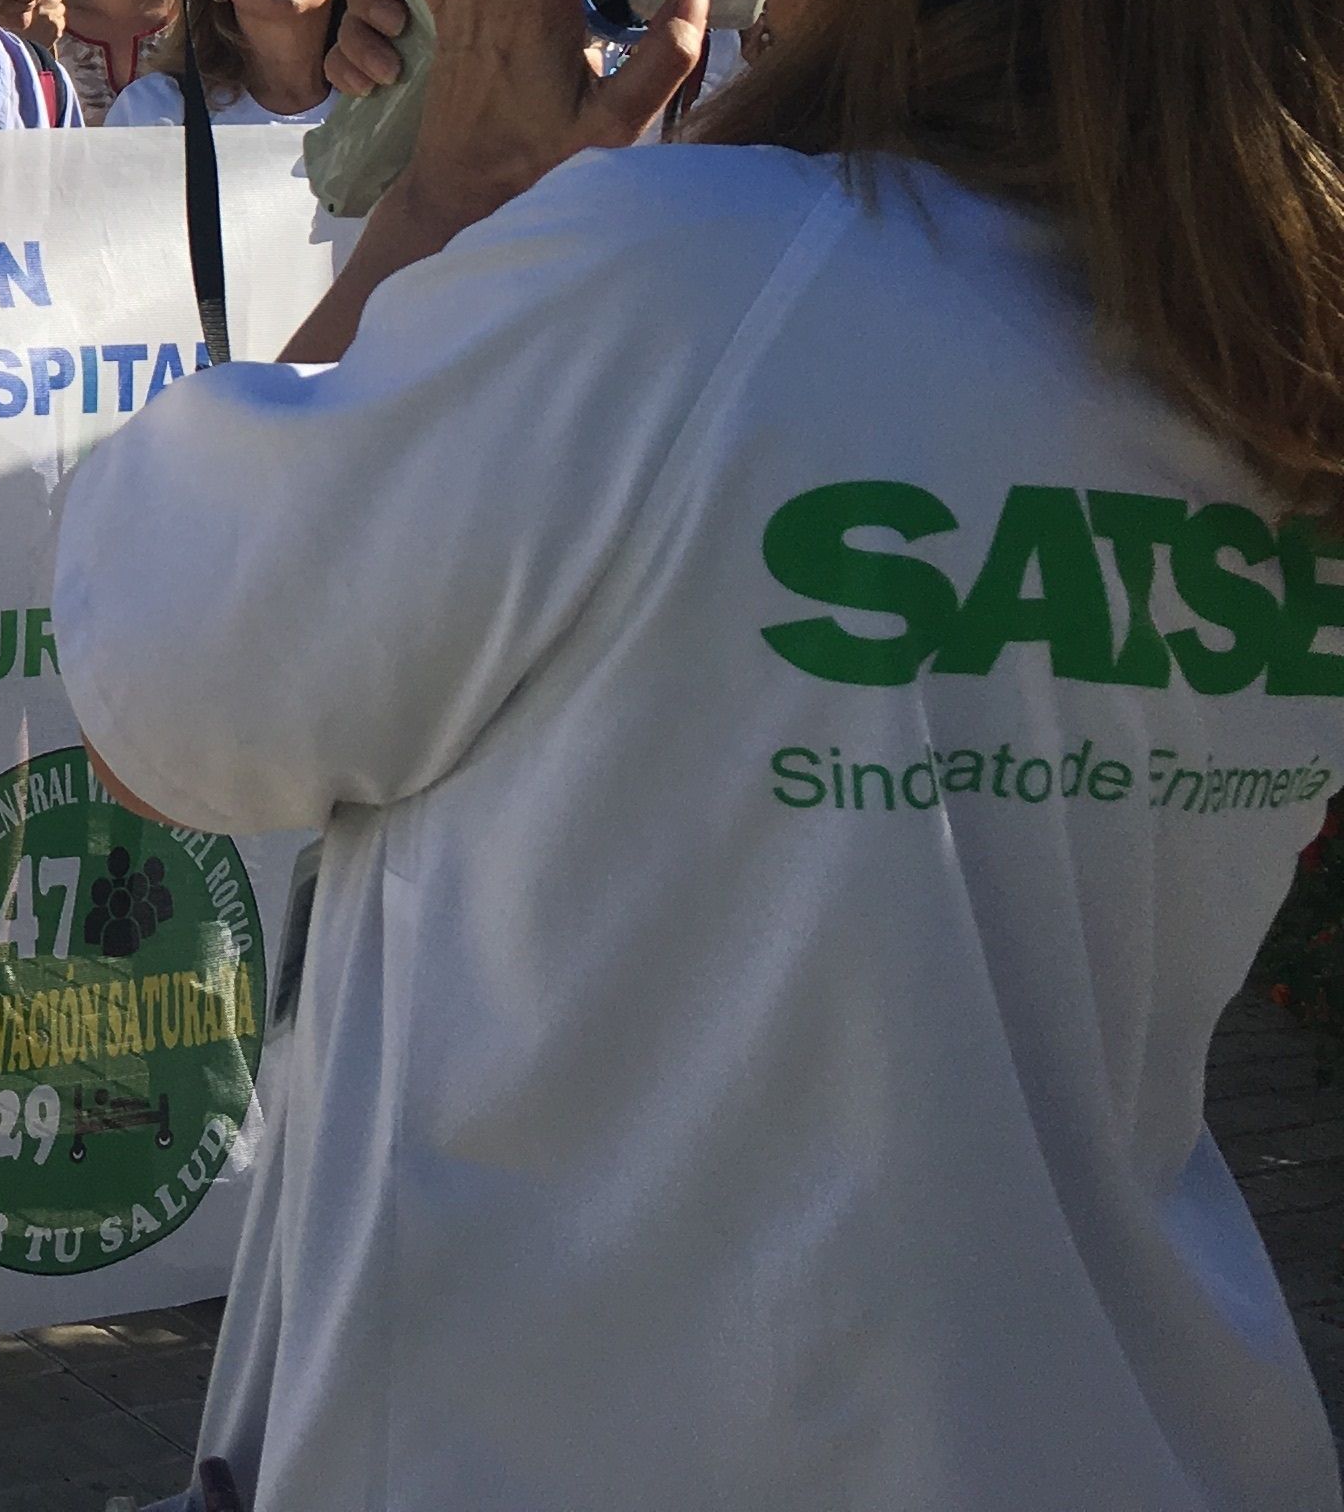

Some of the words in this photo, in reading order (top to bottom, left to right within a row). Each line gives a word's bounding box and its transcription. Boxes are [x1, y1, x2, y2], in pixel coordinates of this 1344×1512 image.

[760, 480, 1344, 697] SATSE
[24, 1225, 85, 1264] TU
[100, 1115, 227, 1253] SALUD
